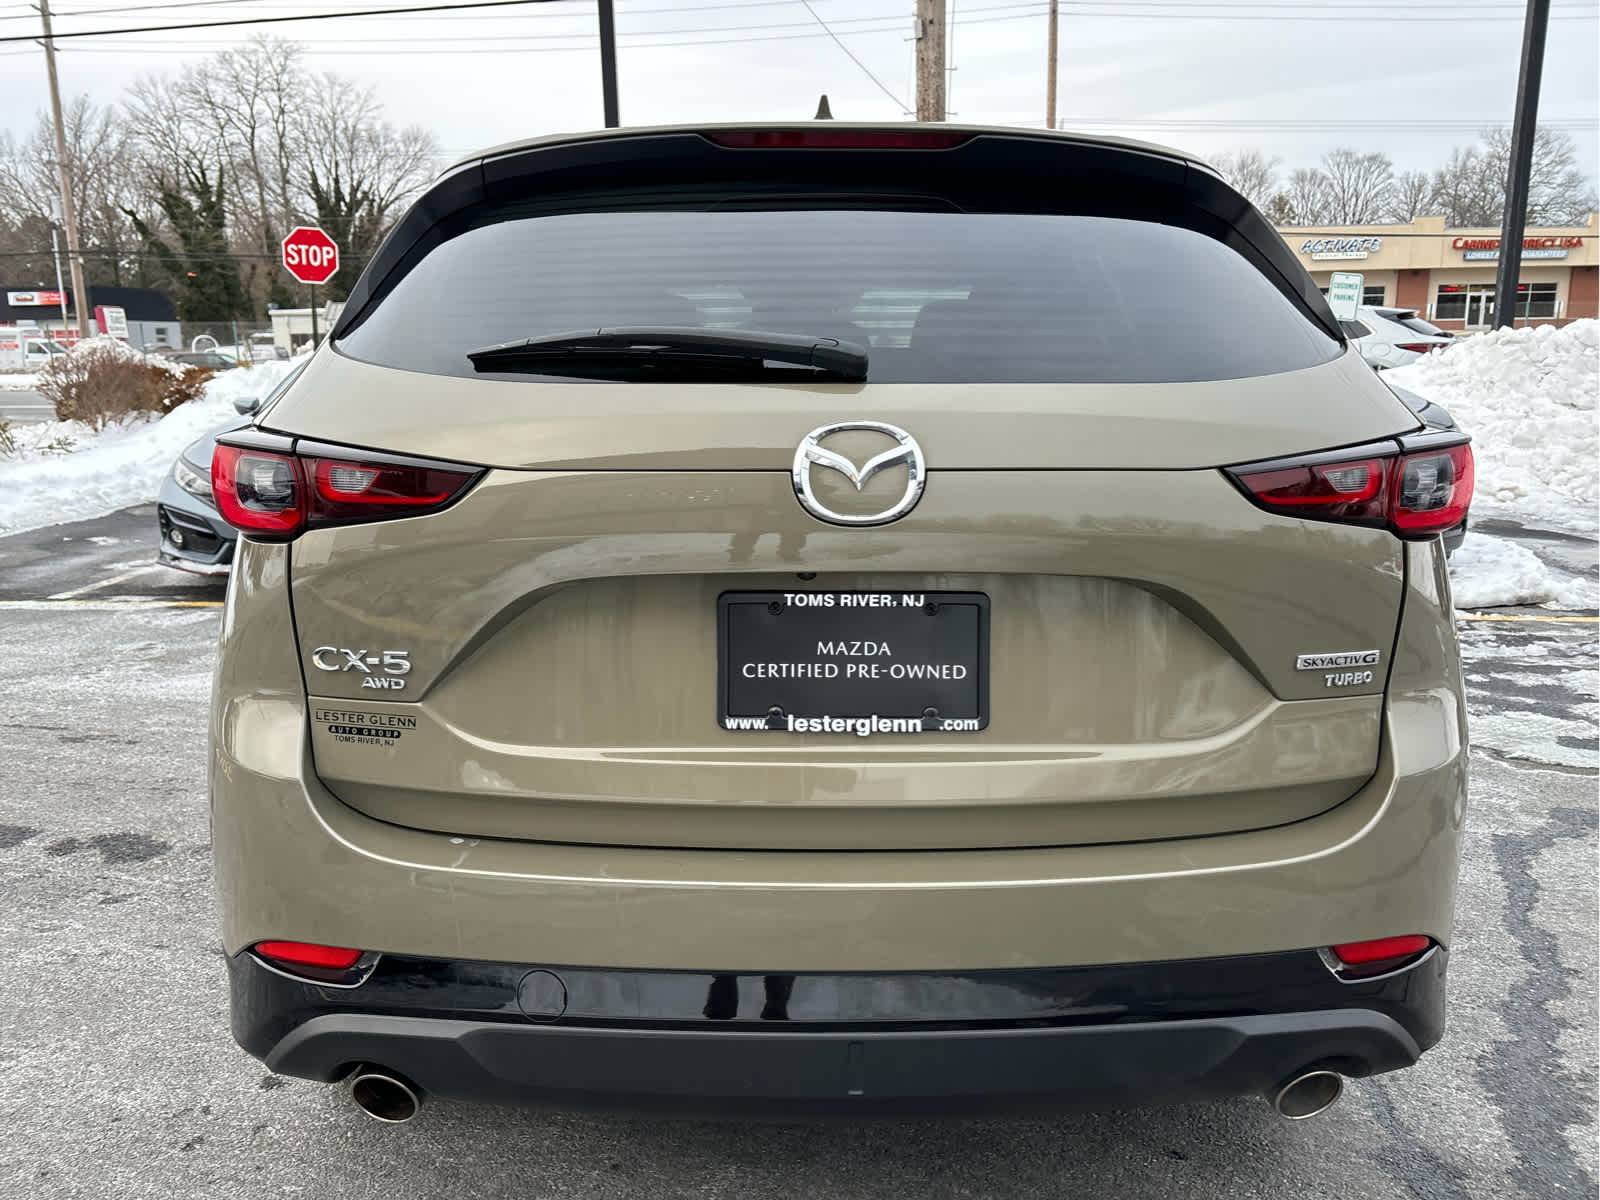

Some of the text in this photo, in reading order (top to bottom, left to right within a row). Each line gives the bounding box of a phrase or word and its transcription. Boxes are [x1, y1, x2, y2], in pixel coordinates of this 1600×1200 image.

[1300, 237, 1382, 253] ACTIVATE
[1560, 236, 1583, 248] USA
[287, 243, 334, 267] STOP
[784, 593, 925, 608] TOMS RIVER, NJ
[816, 641, 892, 656] MAZDA
[312, 646, 412, 675] CX-5
[742, 663, 967, 680] CERTIFIED PRE-OWNED
[1325, 670, 1373, 687] TURBO
[361, 677, 405, 690] AWD
[315, 711, 417, 728] LESTER GLENN
[725, 714, 979, 736] www. lesterglenn .com
[331, 726, 399, 738] AUTO GROUP
[334, 735, 356, 743] TOMS
[357, 736, 383, 746] RIVER,
